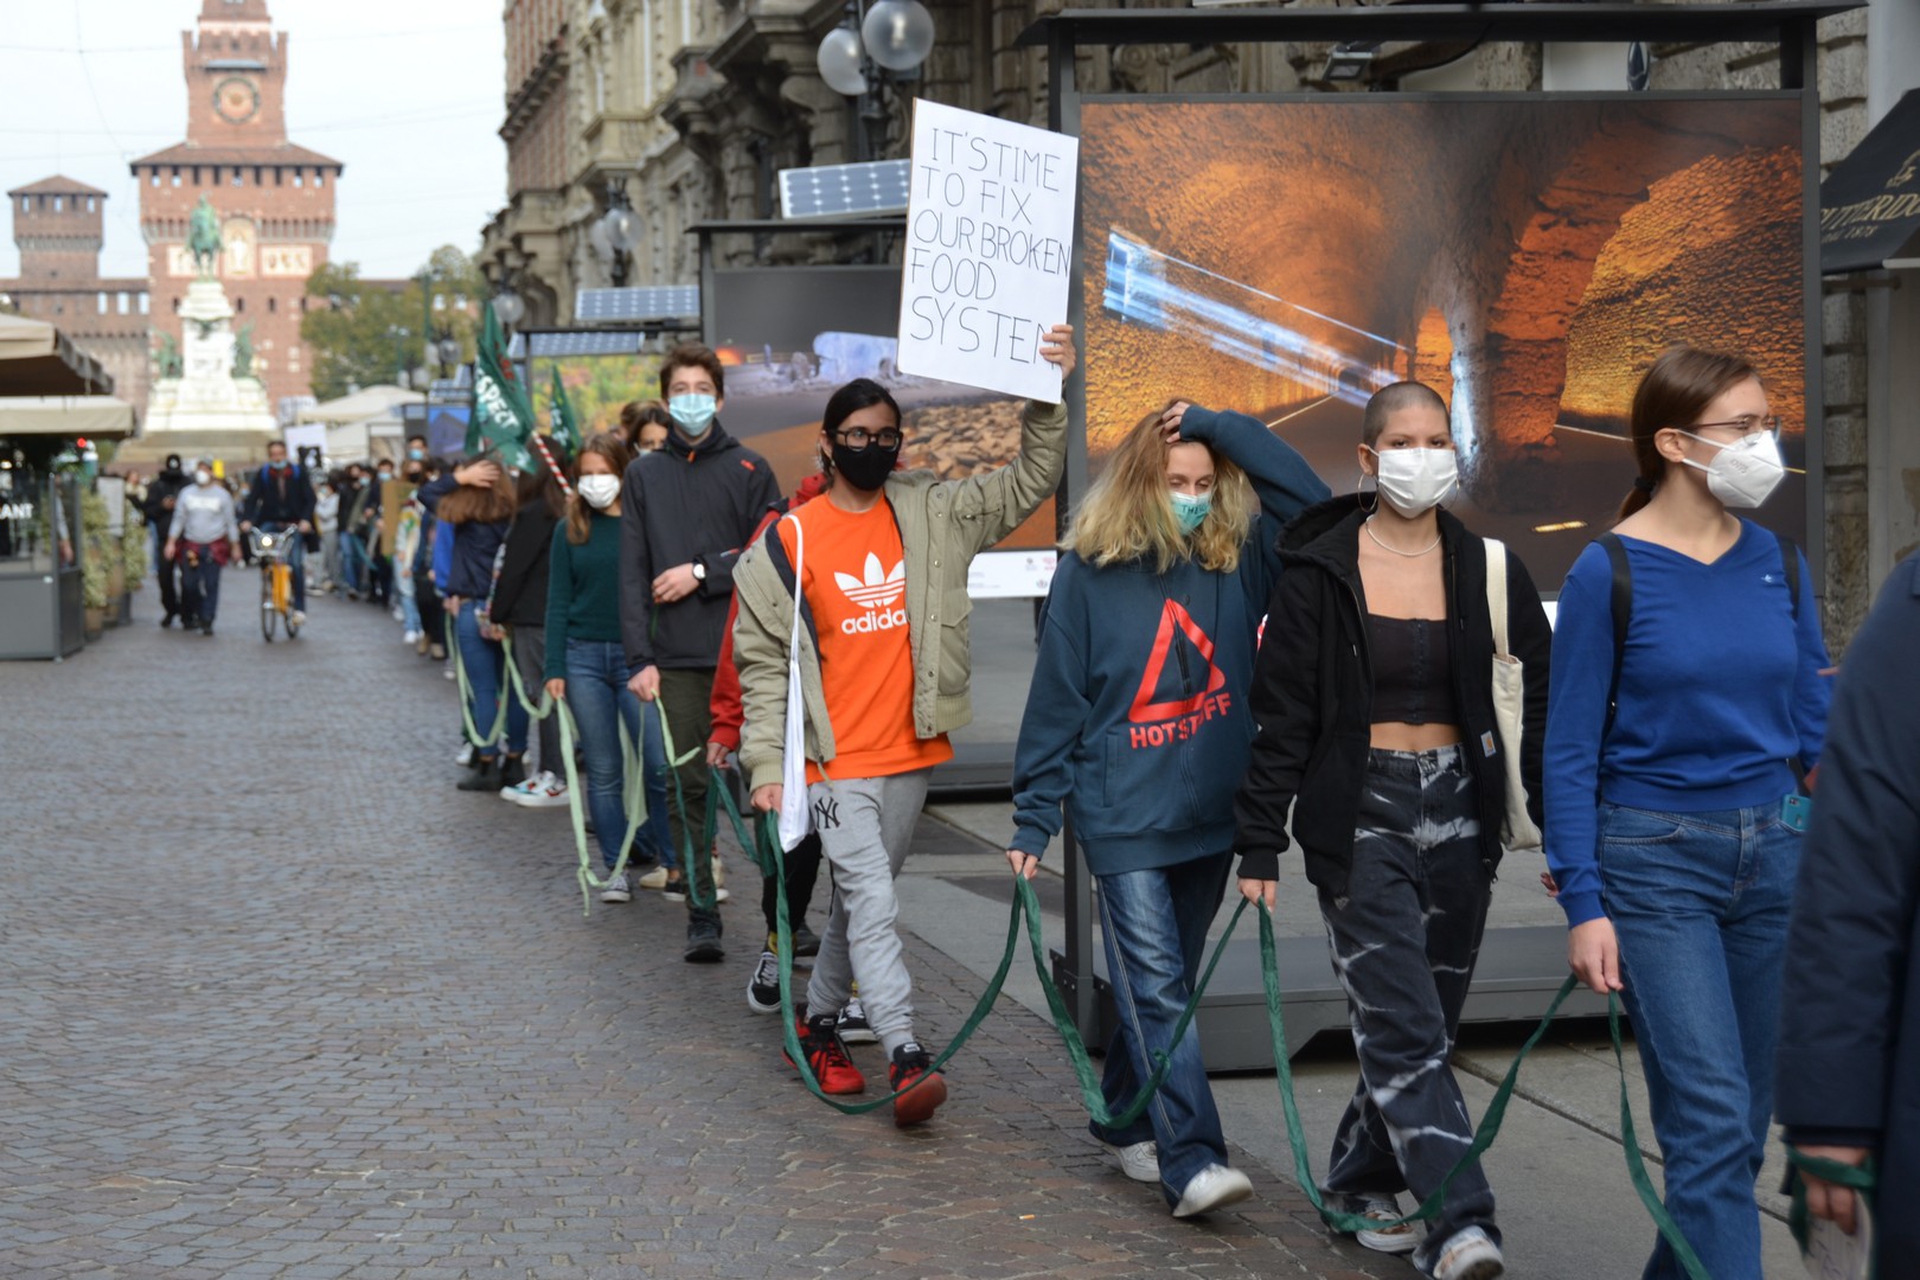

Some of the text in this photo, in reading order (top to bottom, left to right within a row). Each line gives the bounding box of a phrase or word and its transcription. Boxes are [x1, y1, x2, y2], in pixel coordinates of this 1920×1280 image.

[992, 141, 1061, 192] TIME
[920, 165, 1032, 225] TO FIX
[914, 209, 1071, 278] OUR BROKEN
[911, 247, 996, 300] FOOD
[841, 608, 909, 635] adida
